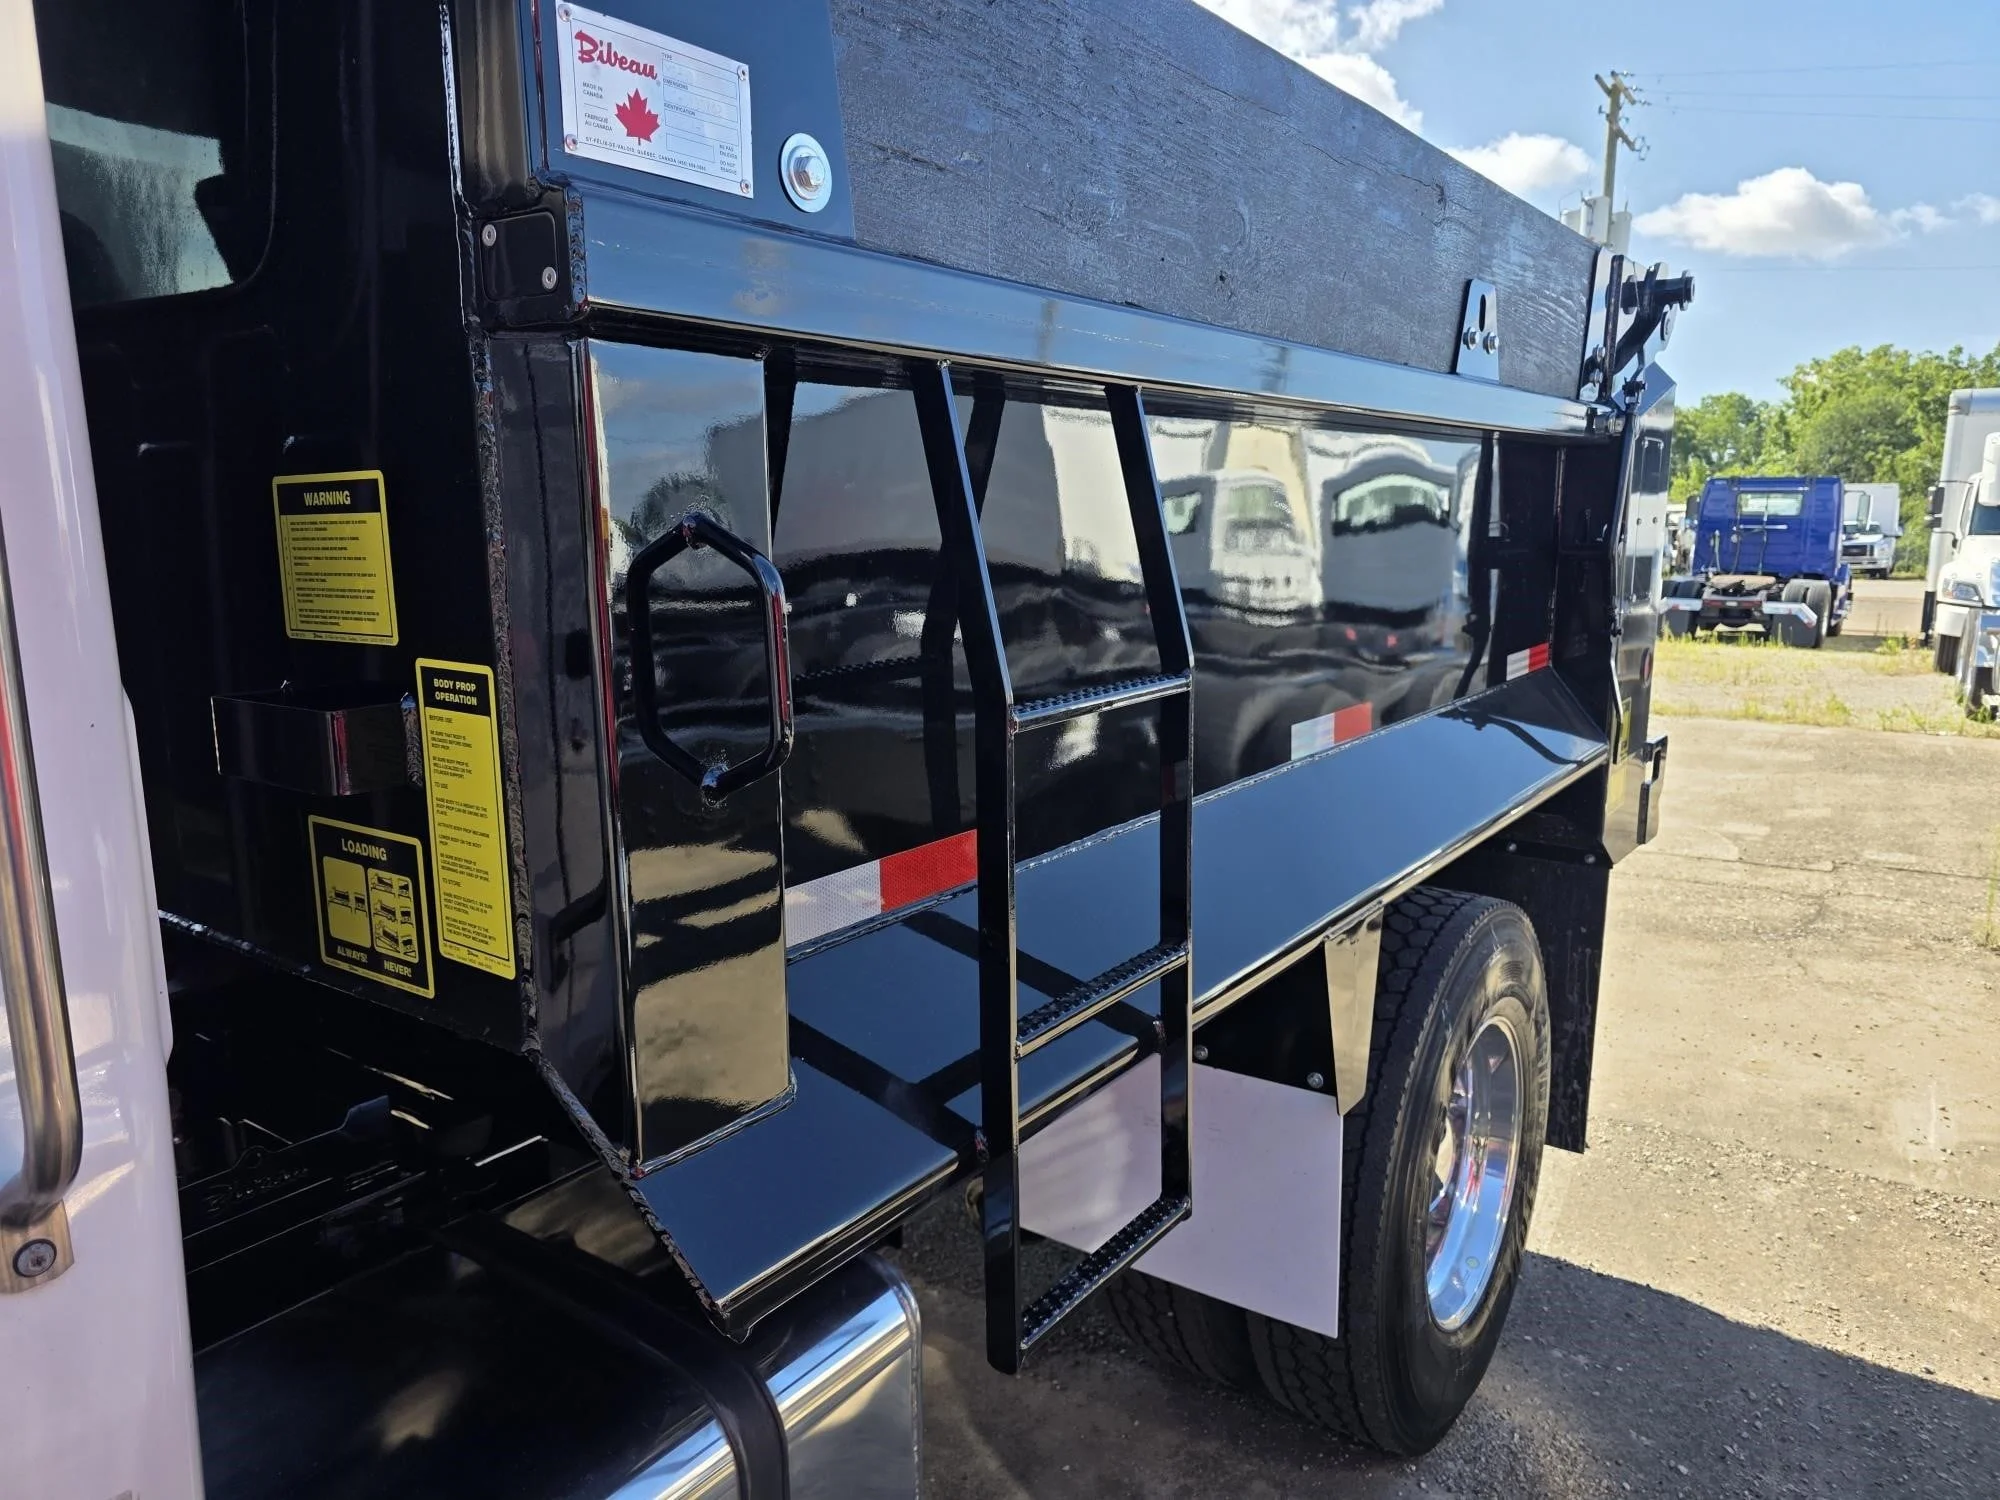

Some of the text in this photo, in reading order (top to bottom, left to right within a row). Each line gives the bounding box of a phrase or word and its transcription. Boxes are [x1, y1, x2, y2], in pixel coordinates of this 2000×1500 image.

[574, 30, 658, 81] Bibeau
[582, 82, 597, 91] MADE
[662, 78, 689, 91] DIMENSIONS
[582, 89, 604, 99] CANADA
[592, 122, 613, 132] CANADA
[658, 154, 677, 164] CANADA
[303, 490, 351, 506] WARNING
[433, 678, 477, 693] BODY PROP
[434, 691, 478, 706] OPERATION
[341, 838, 387, 861] LOADING
[336, 945, 368, 963] ALWAYS!
[383, 960, 412, 977] NEVER!
